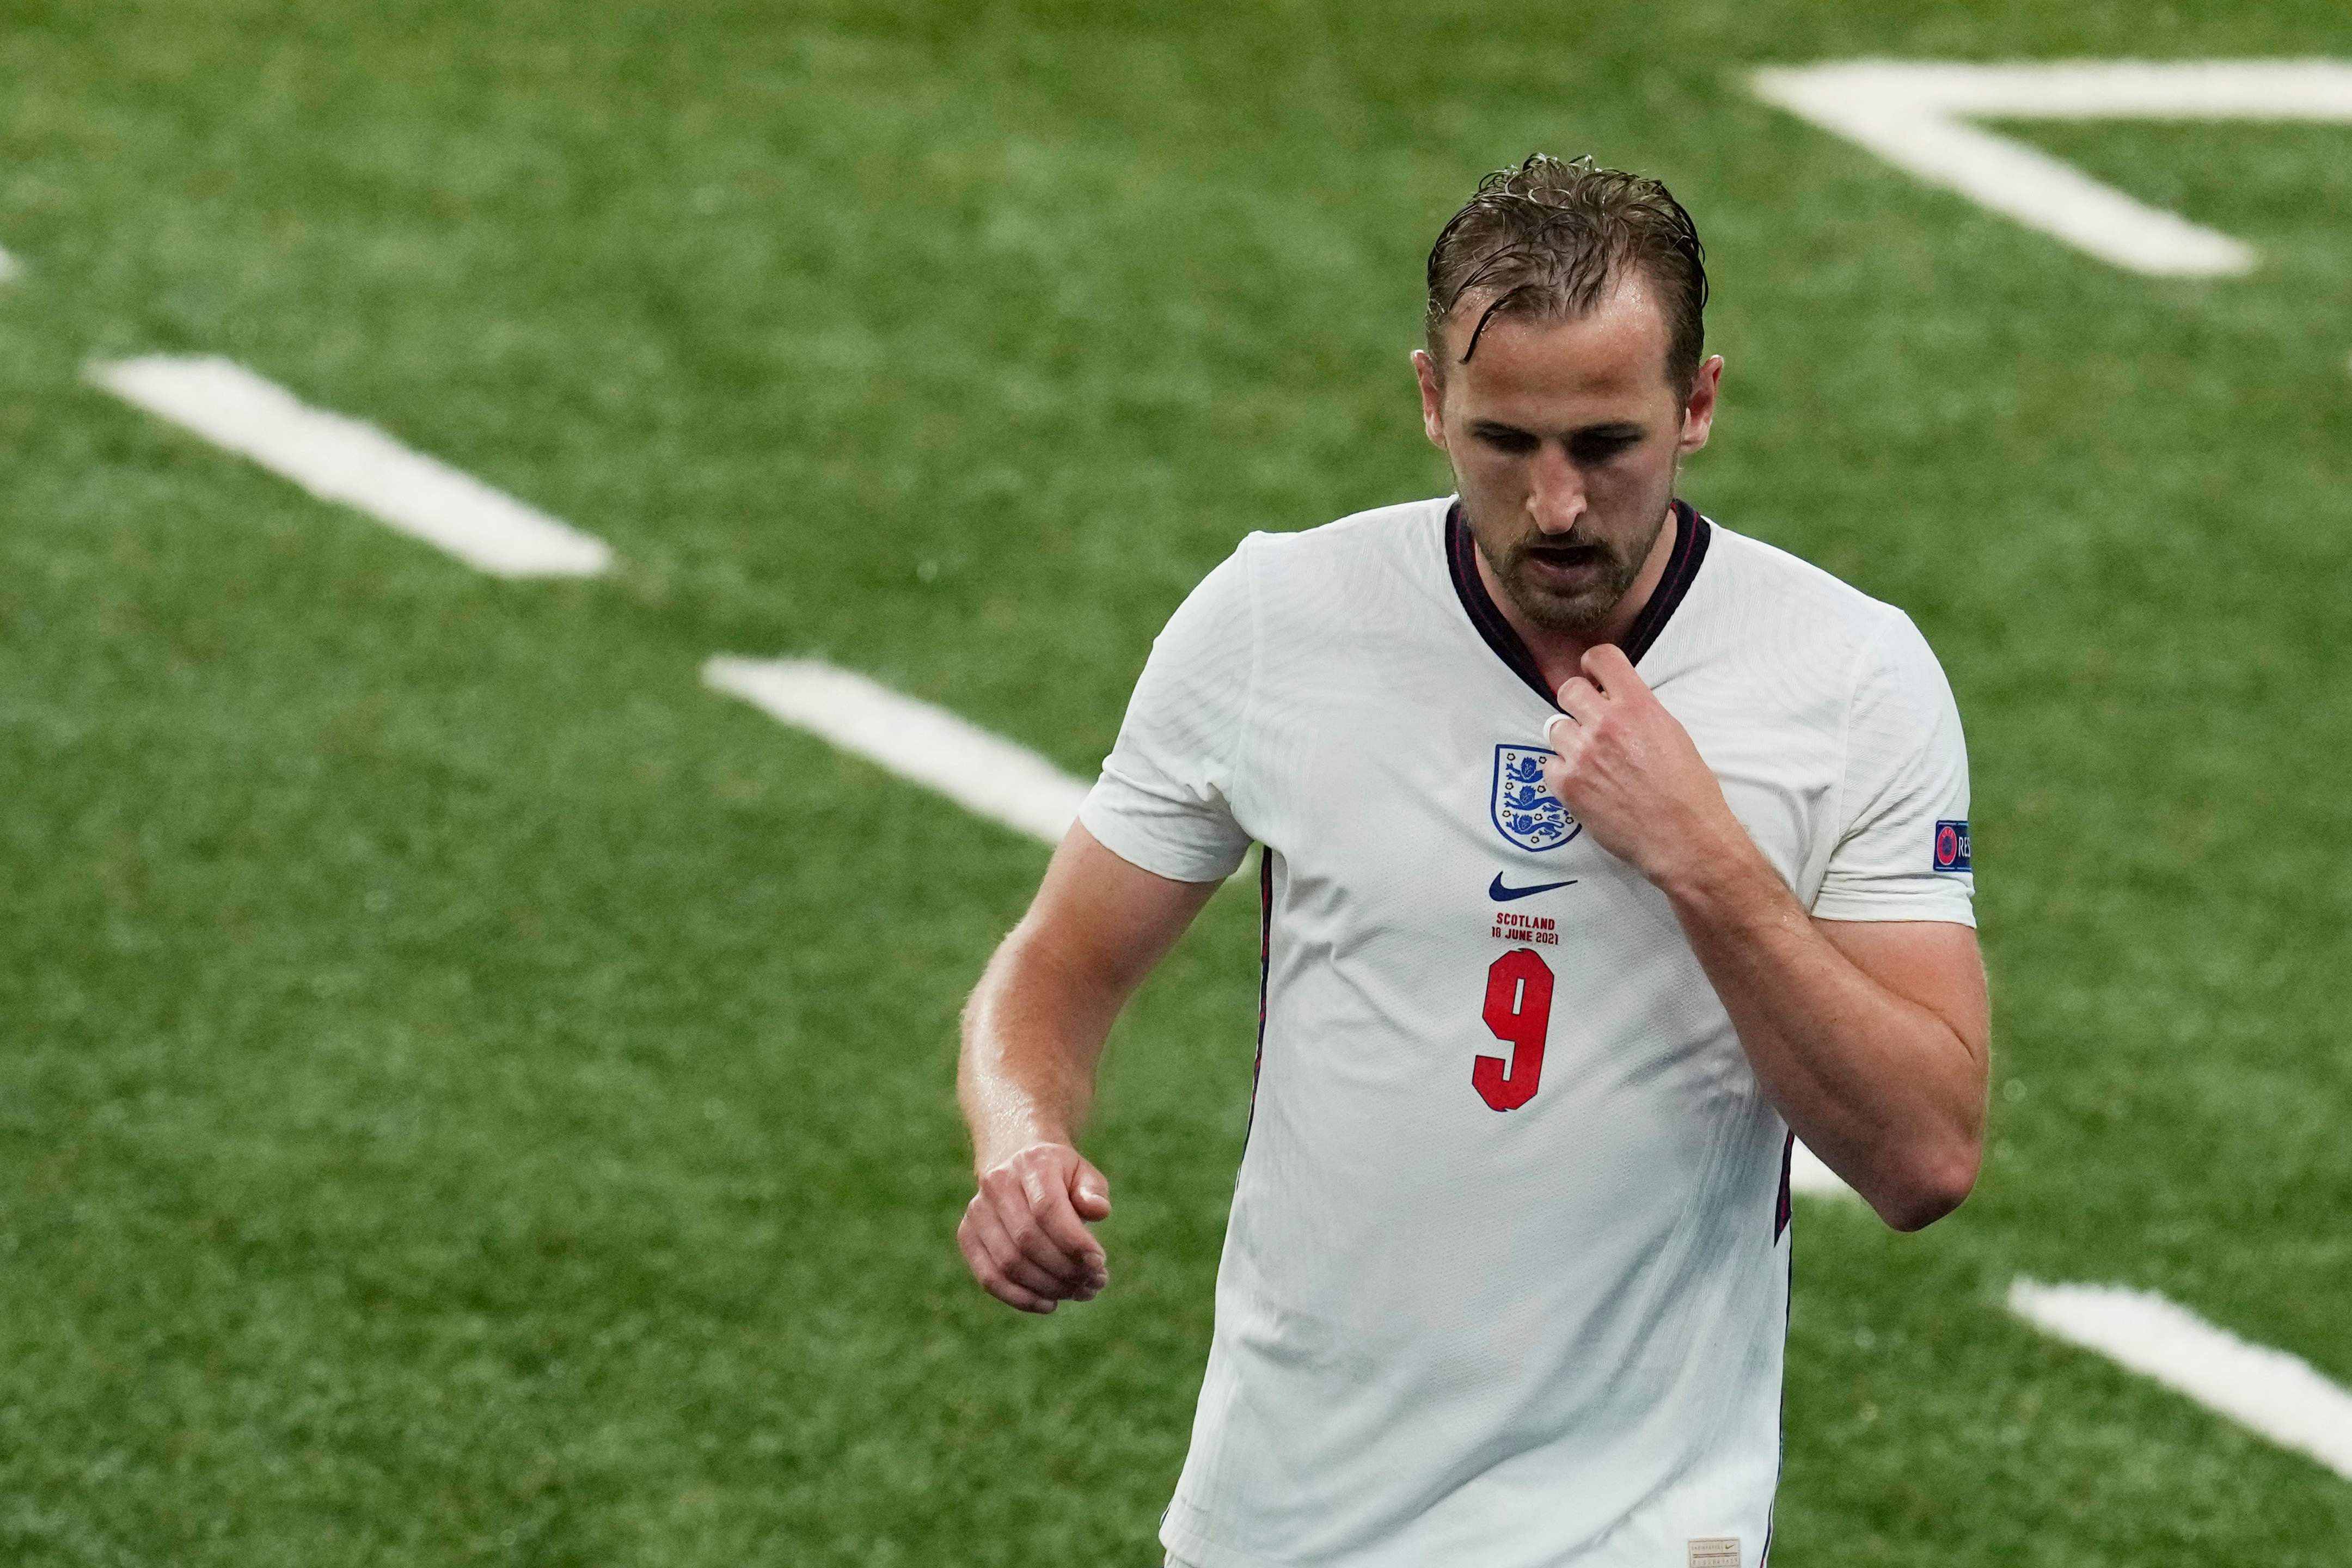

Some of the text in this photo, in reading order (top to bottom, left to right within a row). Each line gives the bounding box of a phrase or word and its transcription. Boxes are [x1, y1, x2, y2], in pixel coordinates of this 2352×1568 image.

[1496, 912, 1555, 930] SCOTLAND
[1492, 926, 1559, 945] 18 JUNE 2021
[1472, 948, 1554, 1112] 9
